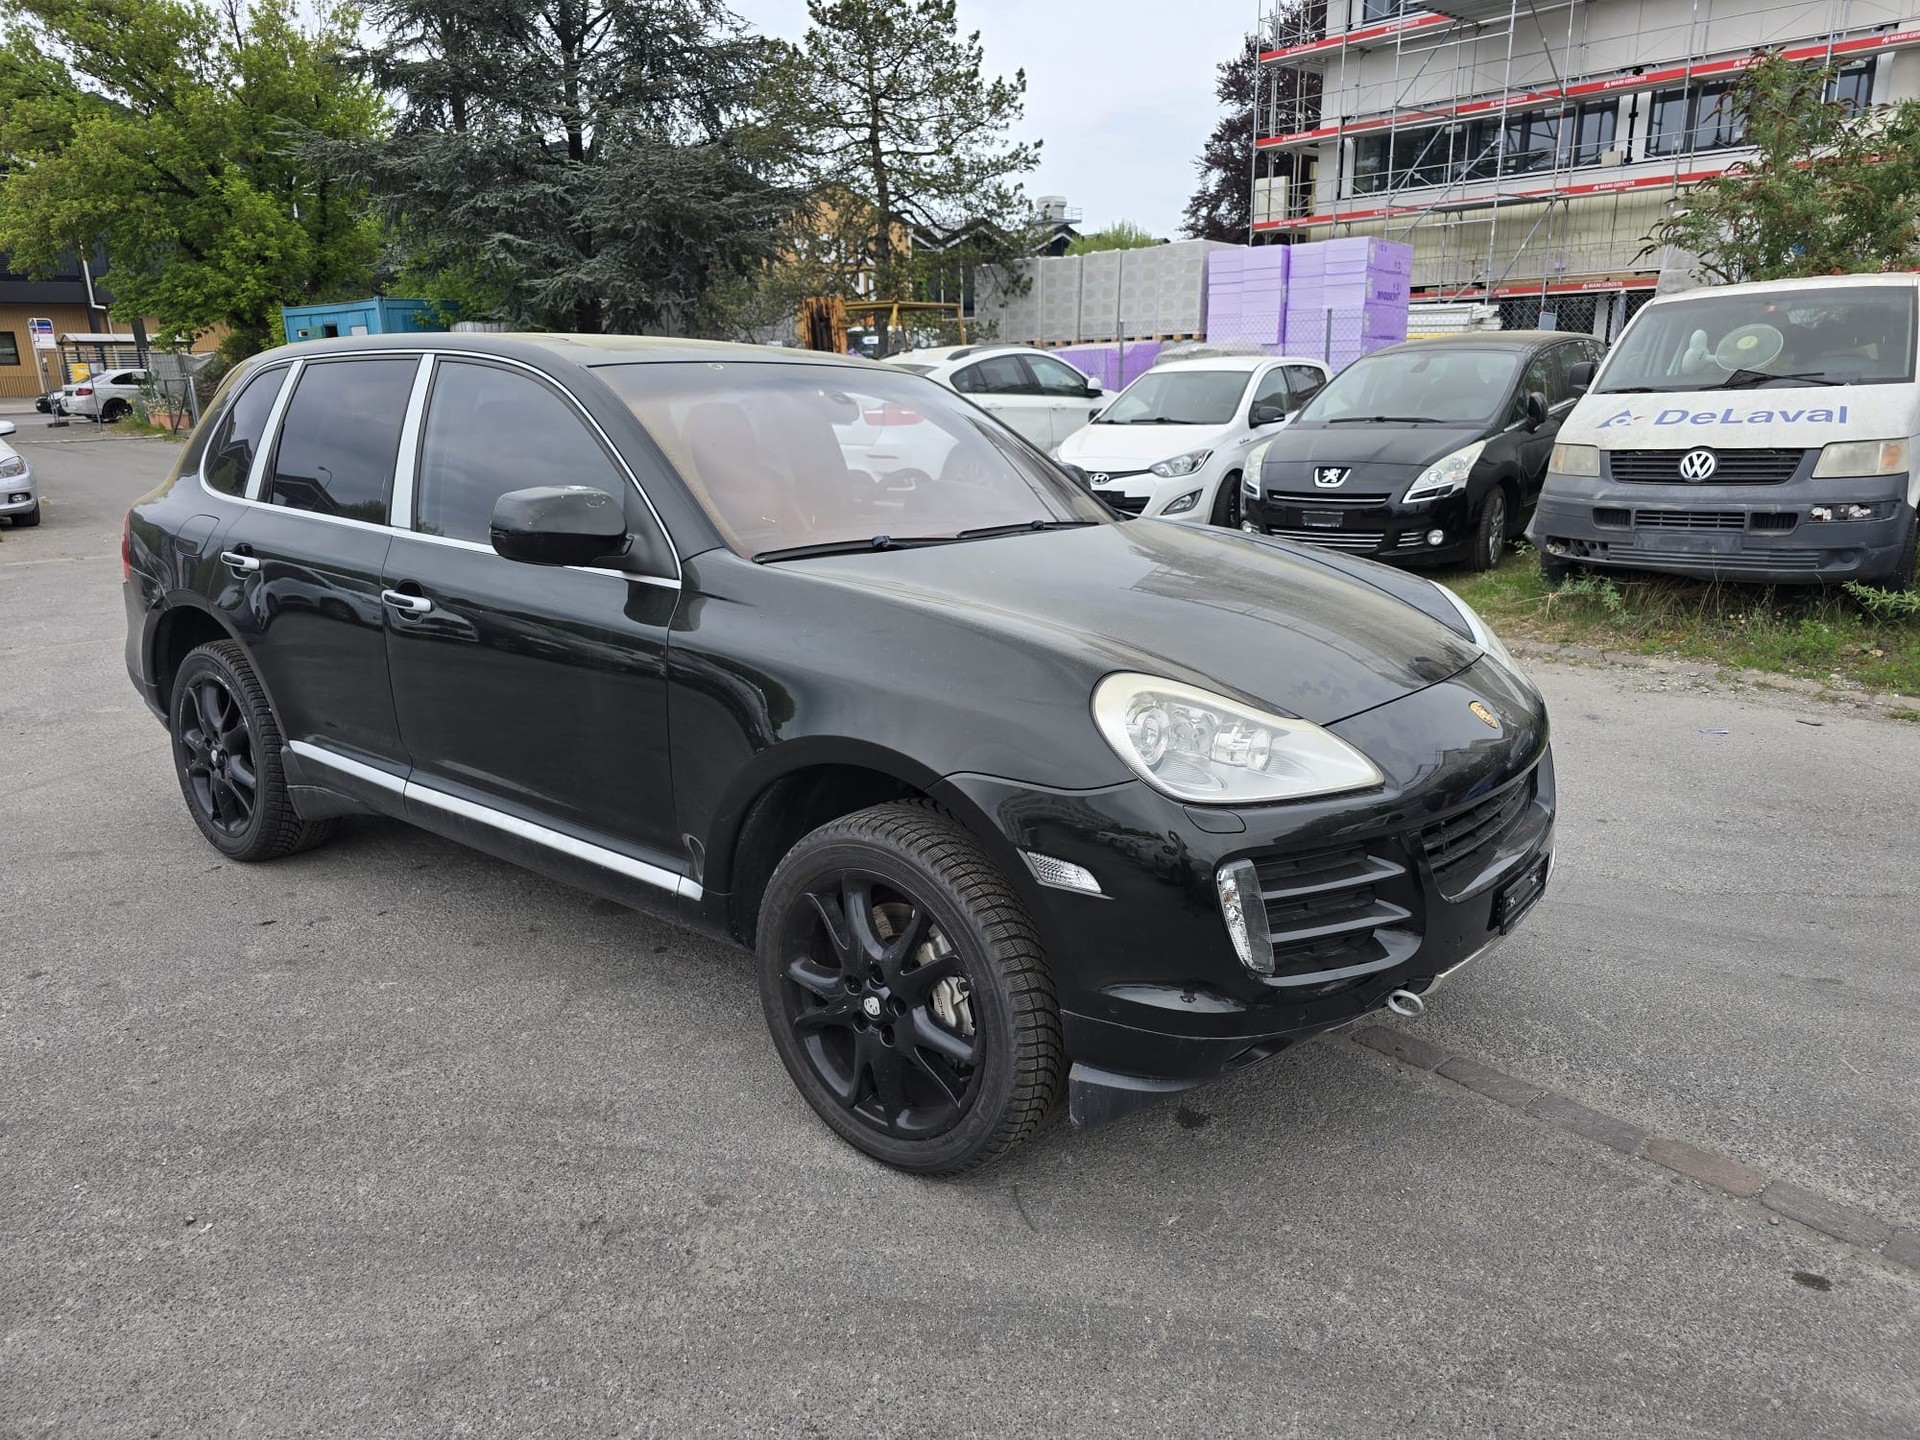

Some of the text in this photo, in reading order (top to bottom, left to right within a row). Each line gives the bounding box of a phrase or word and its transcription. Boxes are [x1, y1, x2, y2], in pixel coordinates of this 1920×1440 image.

[1611, 75, 1647, 86] MANI GERÜSTE
[1654, 406, 1848, 426] DeLaval
[1680, 451, 1716, 480] VW
